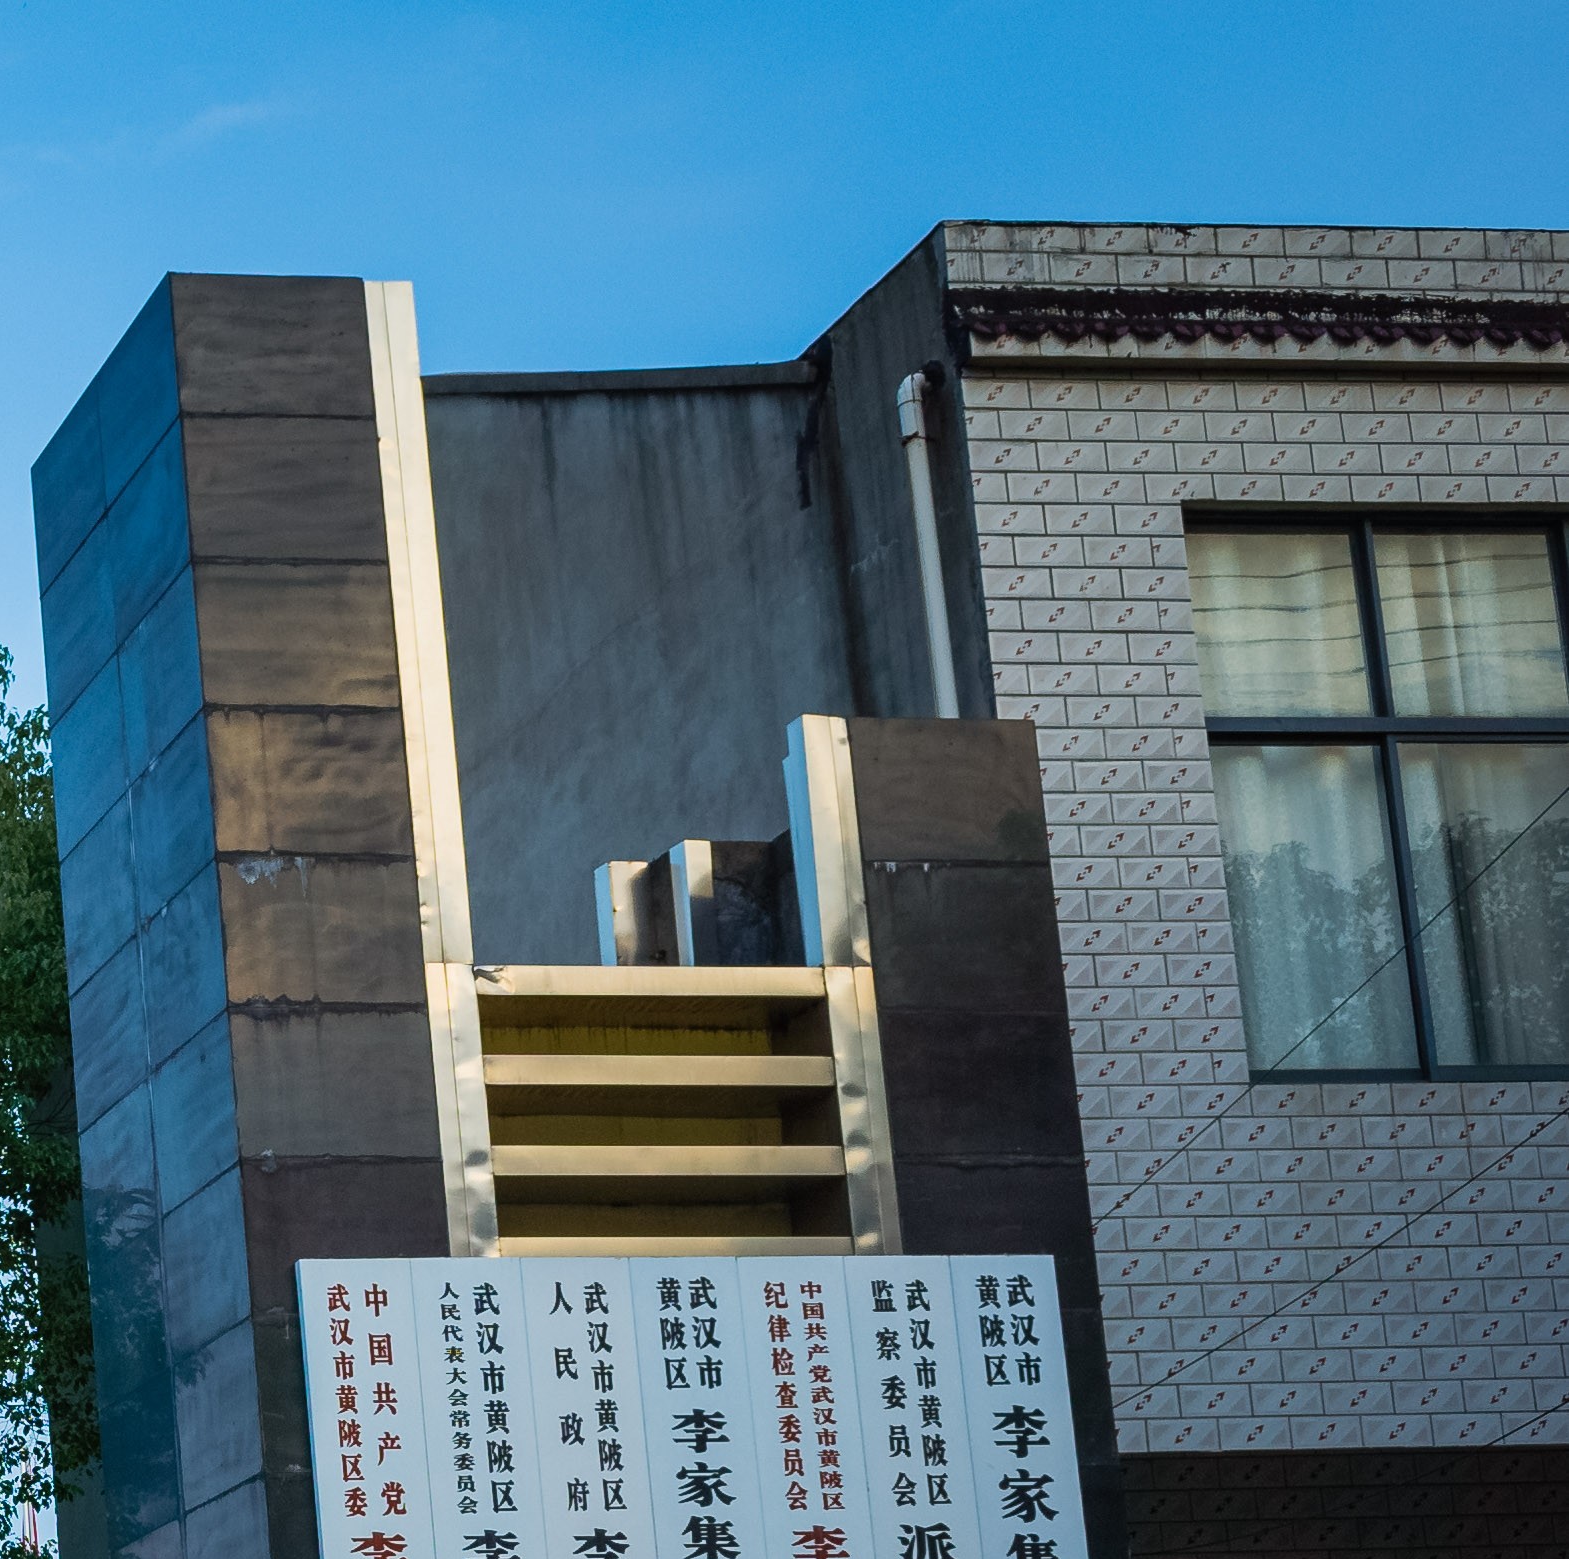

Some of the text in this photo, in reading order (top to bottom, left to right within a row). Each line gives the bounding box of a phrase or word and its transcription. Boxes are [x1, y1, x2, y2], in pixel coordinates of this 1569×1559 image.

[327, 1284, 368, 1516] 武汉市黄陂区委
[365, 1284, 406, 1516] 中国共产党
[439, 1282, 478, 1514] 人民代表大会常务委员会
[473, 1283, 518, 1513] 武汉市黄陂区
[550, 1282, 589, 1511] 人民政府
[584, 1282, 627, 1511] 武汉市黄陂区
[656, 1277, 690, 1390] 黄陂区
[688, 1277, 723, 1389] 武汉市
[764, 1282, 808, 1510] 纪律检查委员会
[800, 1281, 845, 1510] 中国共产党武汉市黄陂区
[871, 1280, 917, 1506] 监察委员会
[905, 1280, 952, 1506] 武汉市黄陂区
[975, 1275, 1011, 1387] 黄陂区
[1006, 1274, 1042, 1385] 武汉市
